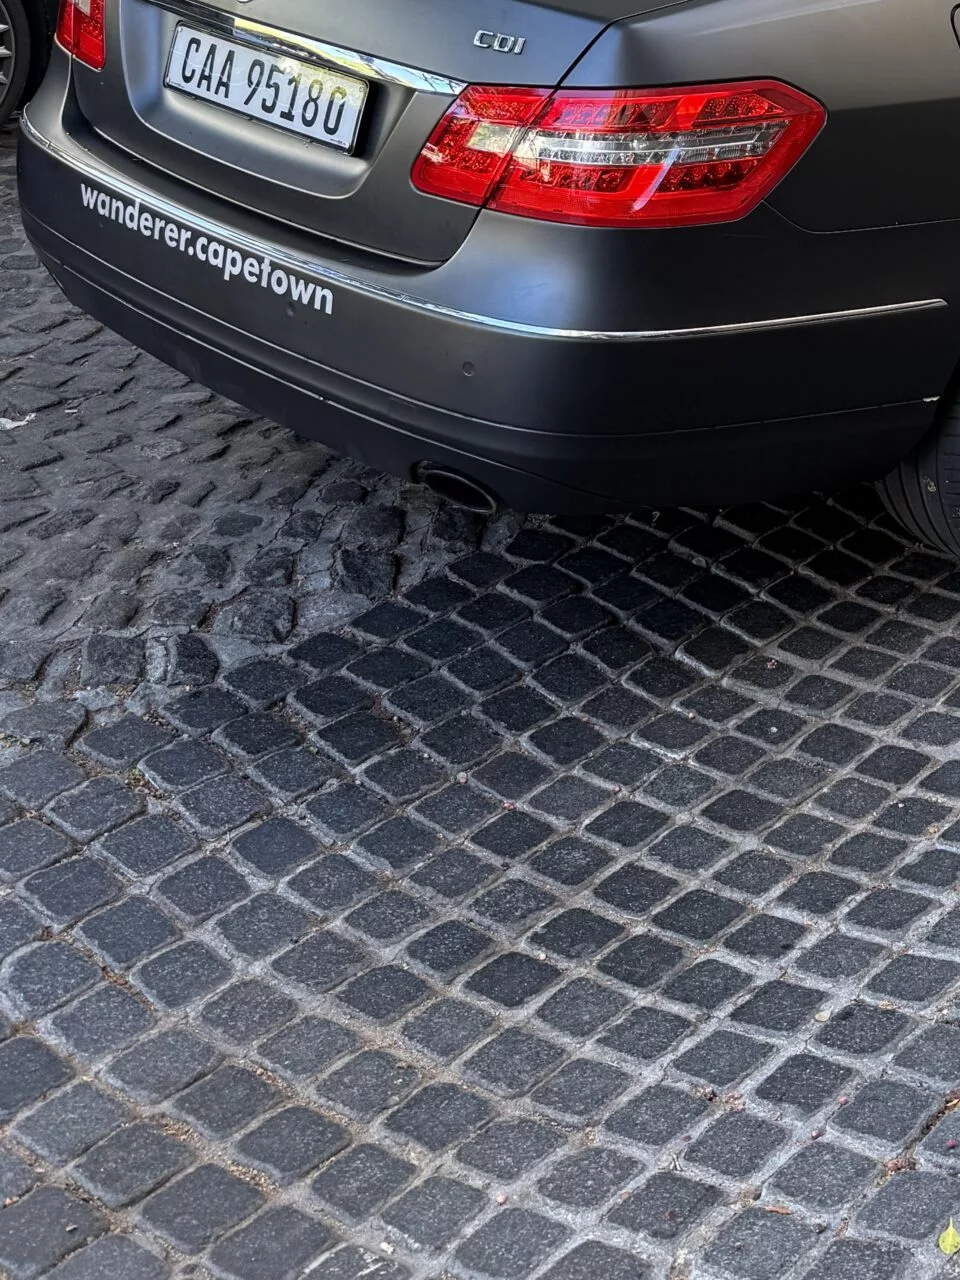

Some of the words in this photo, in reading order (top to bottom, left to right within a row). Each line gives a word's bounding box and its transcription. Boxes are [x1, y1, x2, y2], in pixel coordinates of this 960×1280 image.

[181, 37, 236, 99] CAA
[243, 58, 348, 136] 95180
[473, 29, 526, 55] CDI
[80, 183, 334, 315] wanderer.capetown
